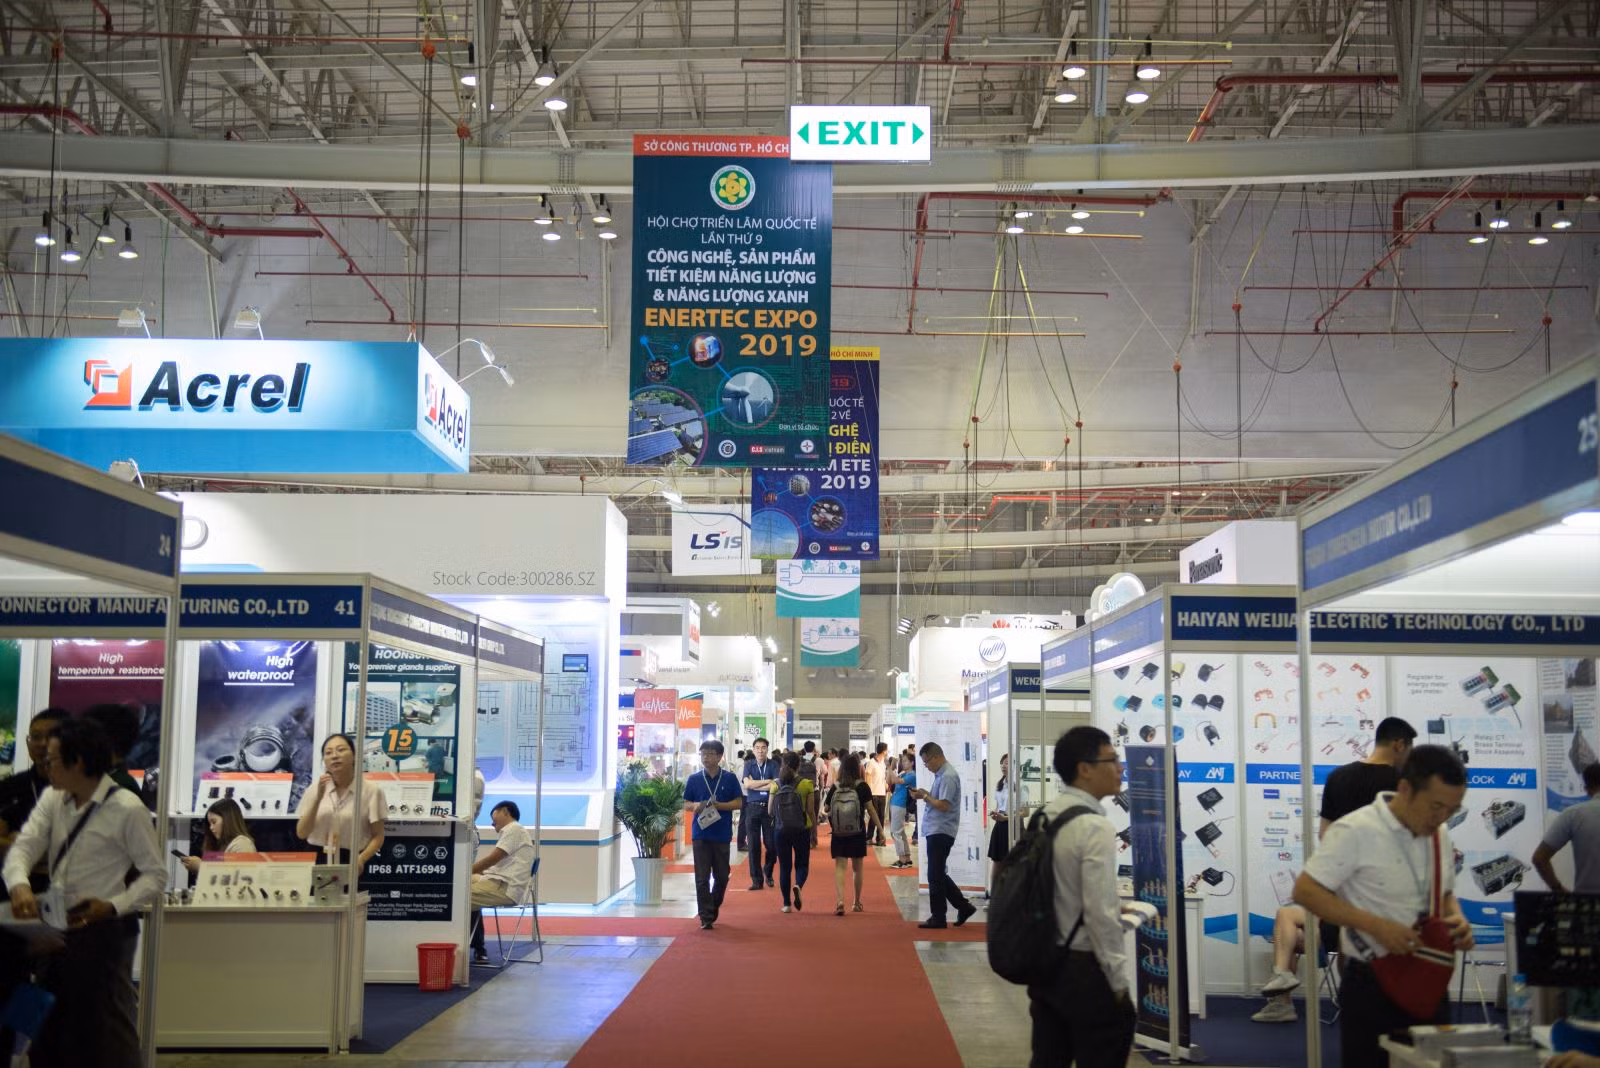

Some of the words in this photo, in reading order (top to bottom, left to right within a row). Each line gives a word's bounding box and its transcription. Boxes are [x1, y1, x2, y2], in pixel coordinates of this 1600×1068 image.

[818, 121, 906, 145] EXIT
[644, 139, 659, 152] SỞ
[660, 139, 689, 152] CÔNG
[692, 140, 736, 153] THƯƠNG
[739, 142, 755, 153] TP.
[775, 143, 790, 154] CH
[647, 214, 668, 229] HỘI
[671, 216, 699, 229] CHỢ
[700, 214, 733, 229] TRIỂN
[736, 216, 762, 229] LÃM
[765, 215, 801, 230] QUỐC
[804, 217, 817, 230] TẾ
[727, 231, 753, 245] THỨ
[755, 234, 763, 245] 9
[647, 248, 688, 263] CÔNG
[691, 248, 736, 268] NGHỆ,
[739, 248, 769, 265] SẢN
[772, 248, 816, 265] PHẨM
[646, 266, 677, 283] TIẾT
[679, 266, 715, 287] KIỆM
[719, 268, 761, 284] NĂNG
[764, 270, 816, 288] LƯỢNG
[653, 288, 664, 302] &
[667, 286, 710, 302] NĂNG
[713, 288, 764, 306] LƯỢNG
[767, 290, 809, 303] XANH
[645, 308, 750, 329] ENERTEC
[754, 310, 817, 329] EXPO
[740, 334, 817, 356] 2019
[138, 361, 309, 410] Acrel
[829, 396, 851, 408] UỐC
[852, 396, 865, 408] TẾ
[438, 387, 468, 449] Acrel
[829, 422, 859, 440] GHỆ
[835, 440, 871, 458] ĐIỆN
[841, 459, 871, 472] ETE
[820, 475, 871, 489] 2019
[160, 534, 171, 557] 24
[433, 571, 472, 586] Stock
[477, 571, 597, 586] Code:300286.SZ
[0, 597, 91, 613] ONNECTOR
[97, 598, 239, 615] MANUFATURING
[244, 599, 310, 616] CO.,LTD
[333, 600, 356, 615] 41
[1178, 611, 1240, 627] HAIYAN
[1309, 613, 1388, 629] ELECTRIC
[1393, 614, 1506, 631] TECHNOLOGY
[1511, 615, 1545, 633] CO.,
[1551, 615, 1585, 631] LTD
[99, 653, 124, 665] High
[375, 648, 433, 660] HOONS
[266, 655, 294, 669] High
[367, 663, 397, 672] premier
[397, 663, 424, 673] glands
[424, 664, 456, 673] supplier
[58, 666, 115, 676] temperature
[119, 666, 165, 675] resistance
[228, 669, 294, 682] waterproof
[1015, 676, 1041, 686] WENZ
[388, 729, 413, 753] 15
[1260, 770, 1301, 780] PARTNE
[368, 864, 392, 874] IP68
[395, 864, 447, 875] ATF16949
